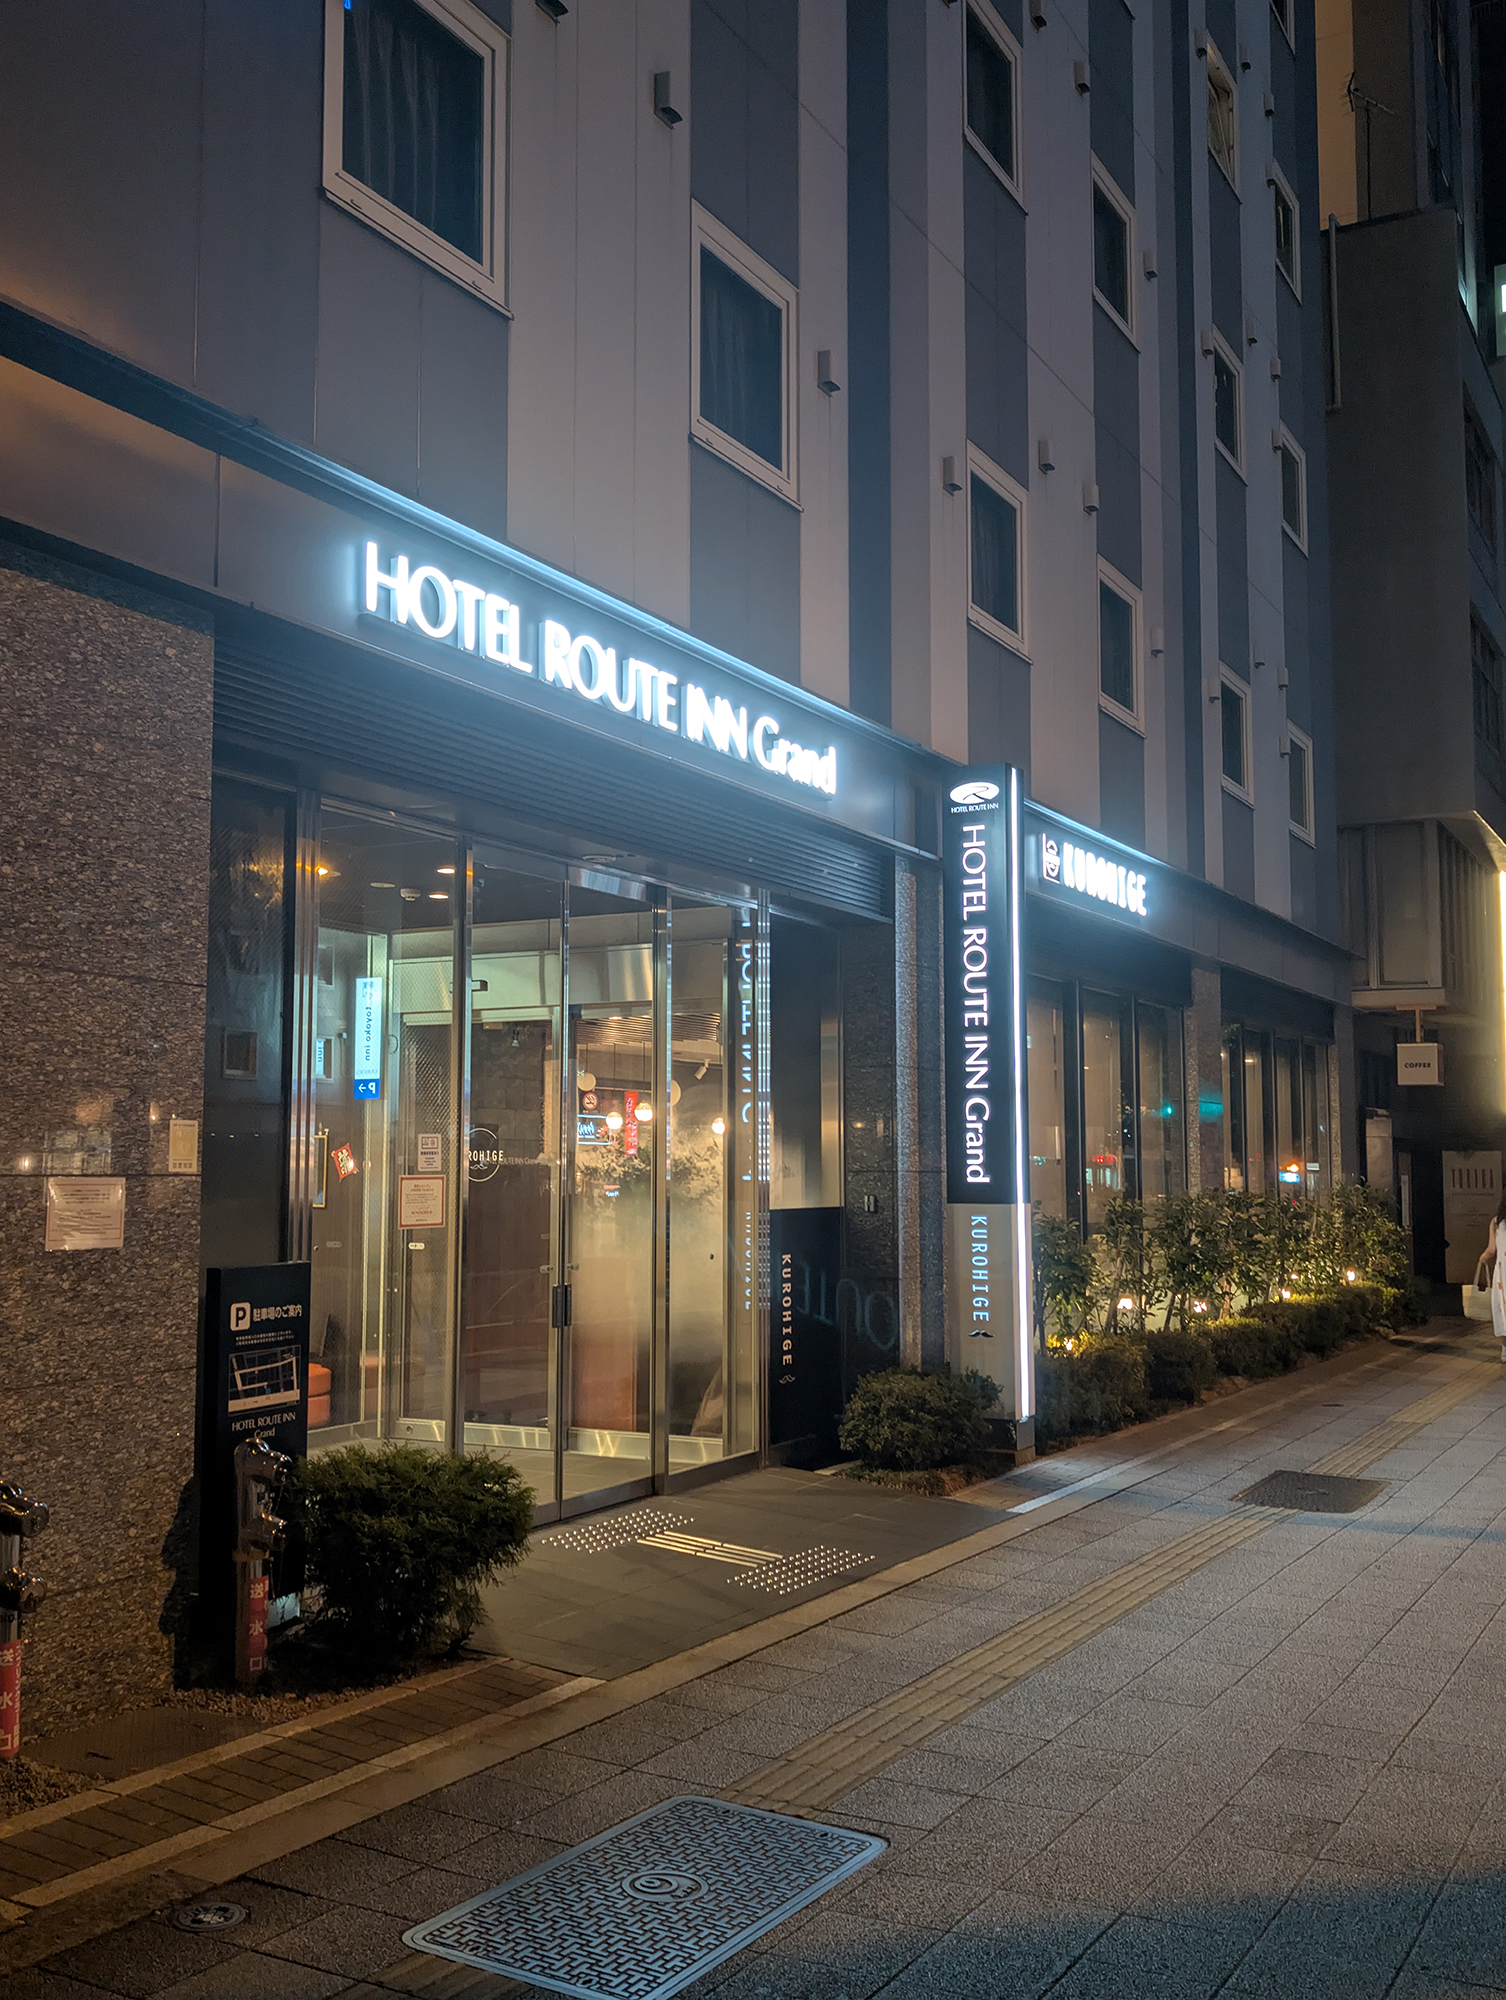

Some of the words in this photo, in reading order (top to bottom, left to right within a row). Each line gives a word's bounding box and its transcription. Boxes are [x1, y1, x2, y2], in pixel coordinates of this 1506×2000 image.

[366, 541, 532, 673] HOTEL
[545, 619, 677, 731] ROUTE
[687, 683, 747, 759] INN
[753, 716, 837, 795] Grand
[968, 804, 987, 812] ROUTE
[962, 824, 987, 921] HOTEL
[1063, 841, 1147, 917] KUROHIGE
[963, 927, 988, 1028] ROUTE
[965, 1035, 989, 1089] INN
[965, 1097, 991, 1184] Grand
[781, 1253, 793, 1366] KUROHIGE
[971, 1215, 990, 1322] KUROHIGE
[235, 1307, 247, 1328] P
[253, 1304, 302, 1322] 駐車場のご案内
[232, 1419, 256, 1431] HOTEL
[258, 1414, 281, 1427] ROUTE
[283, 1412, 295, 1422] INN
[254, 1427, 275, 1439] Grand
[250, 1583, 264, 1671] 送水口
